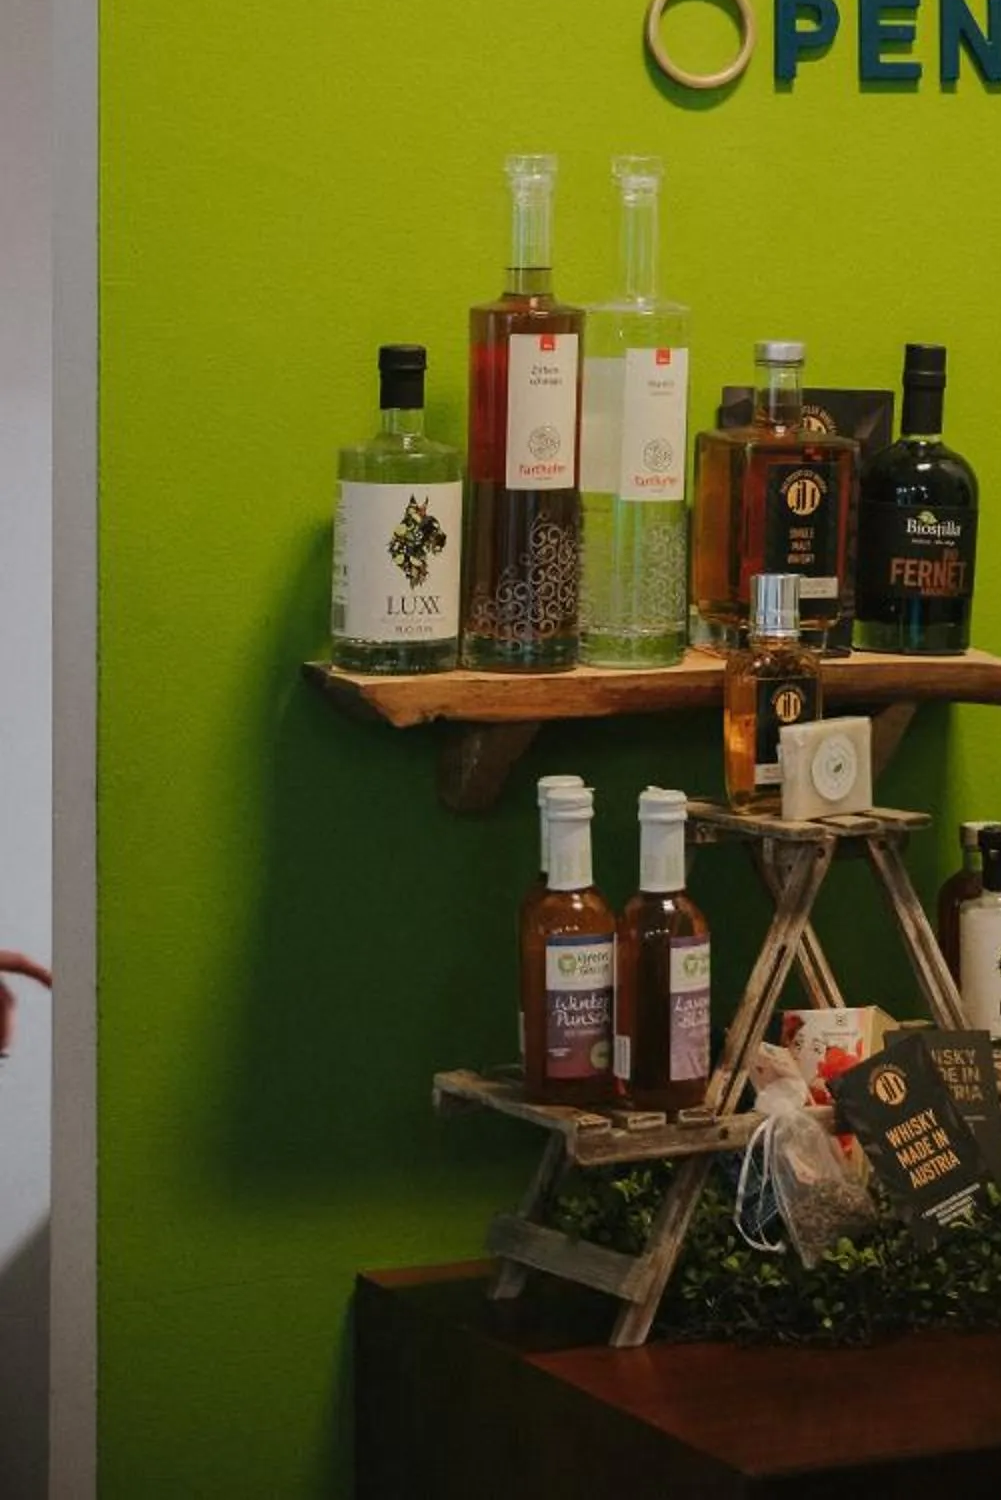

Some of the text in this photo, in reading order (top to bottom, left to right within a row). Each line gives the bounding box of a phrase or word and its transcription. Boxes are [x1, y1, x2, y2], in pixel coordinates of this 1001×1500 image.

[906, 517, 961, 537] Biostilla
[890, 557, 968, 590] FERNET
[385, 595, 442, 616] LUXX
[931, 1046, 976, 1066] ISKY
[949, 1085, 984, 1101] TRIA
[885, 1108, 938, 1148] WHISKY
[896, 1127, 950, 1169] MADE IN
[909, 1147, 961, 1189] AUSTRIA
